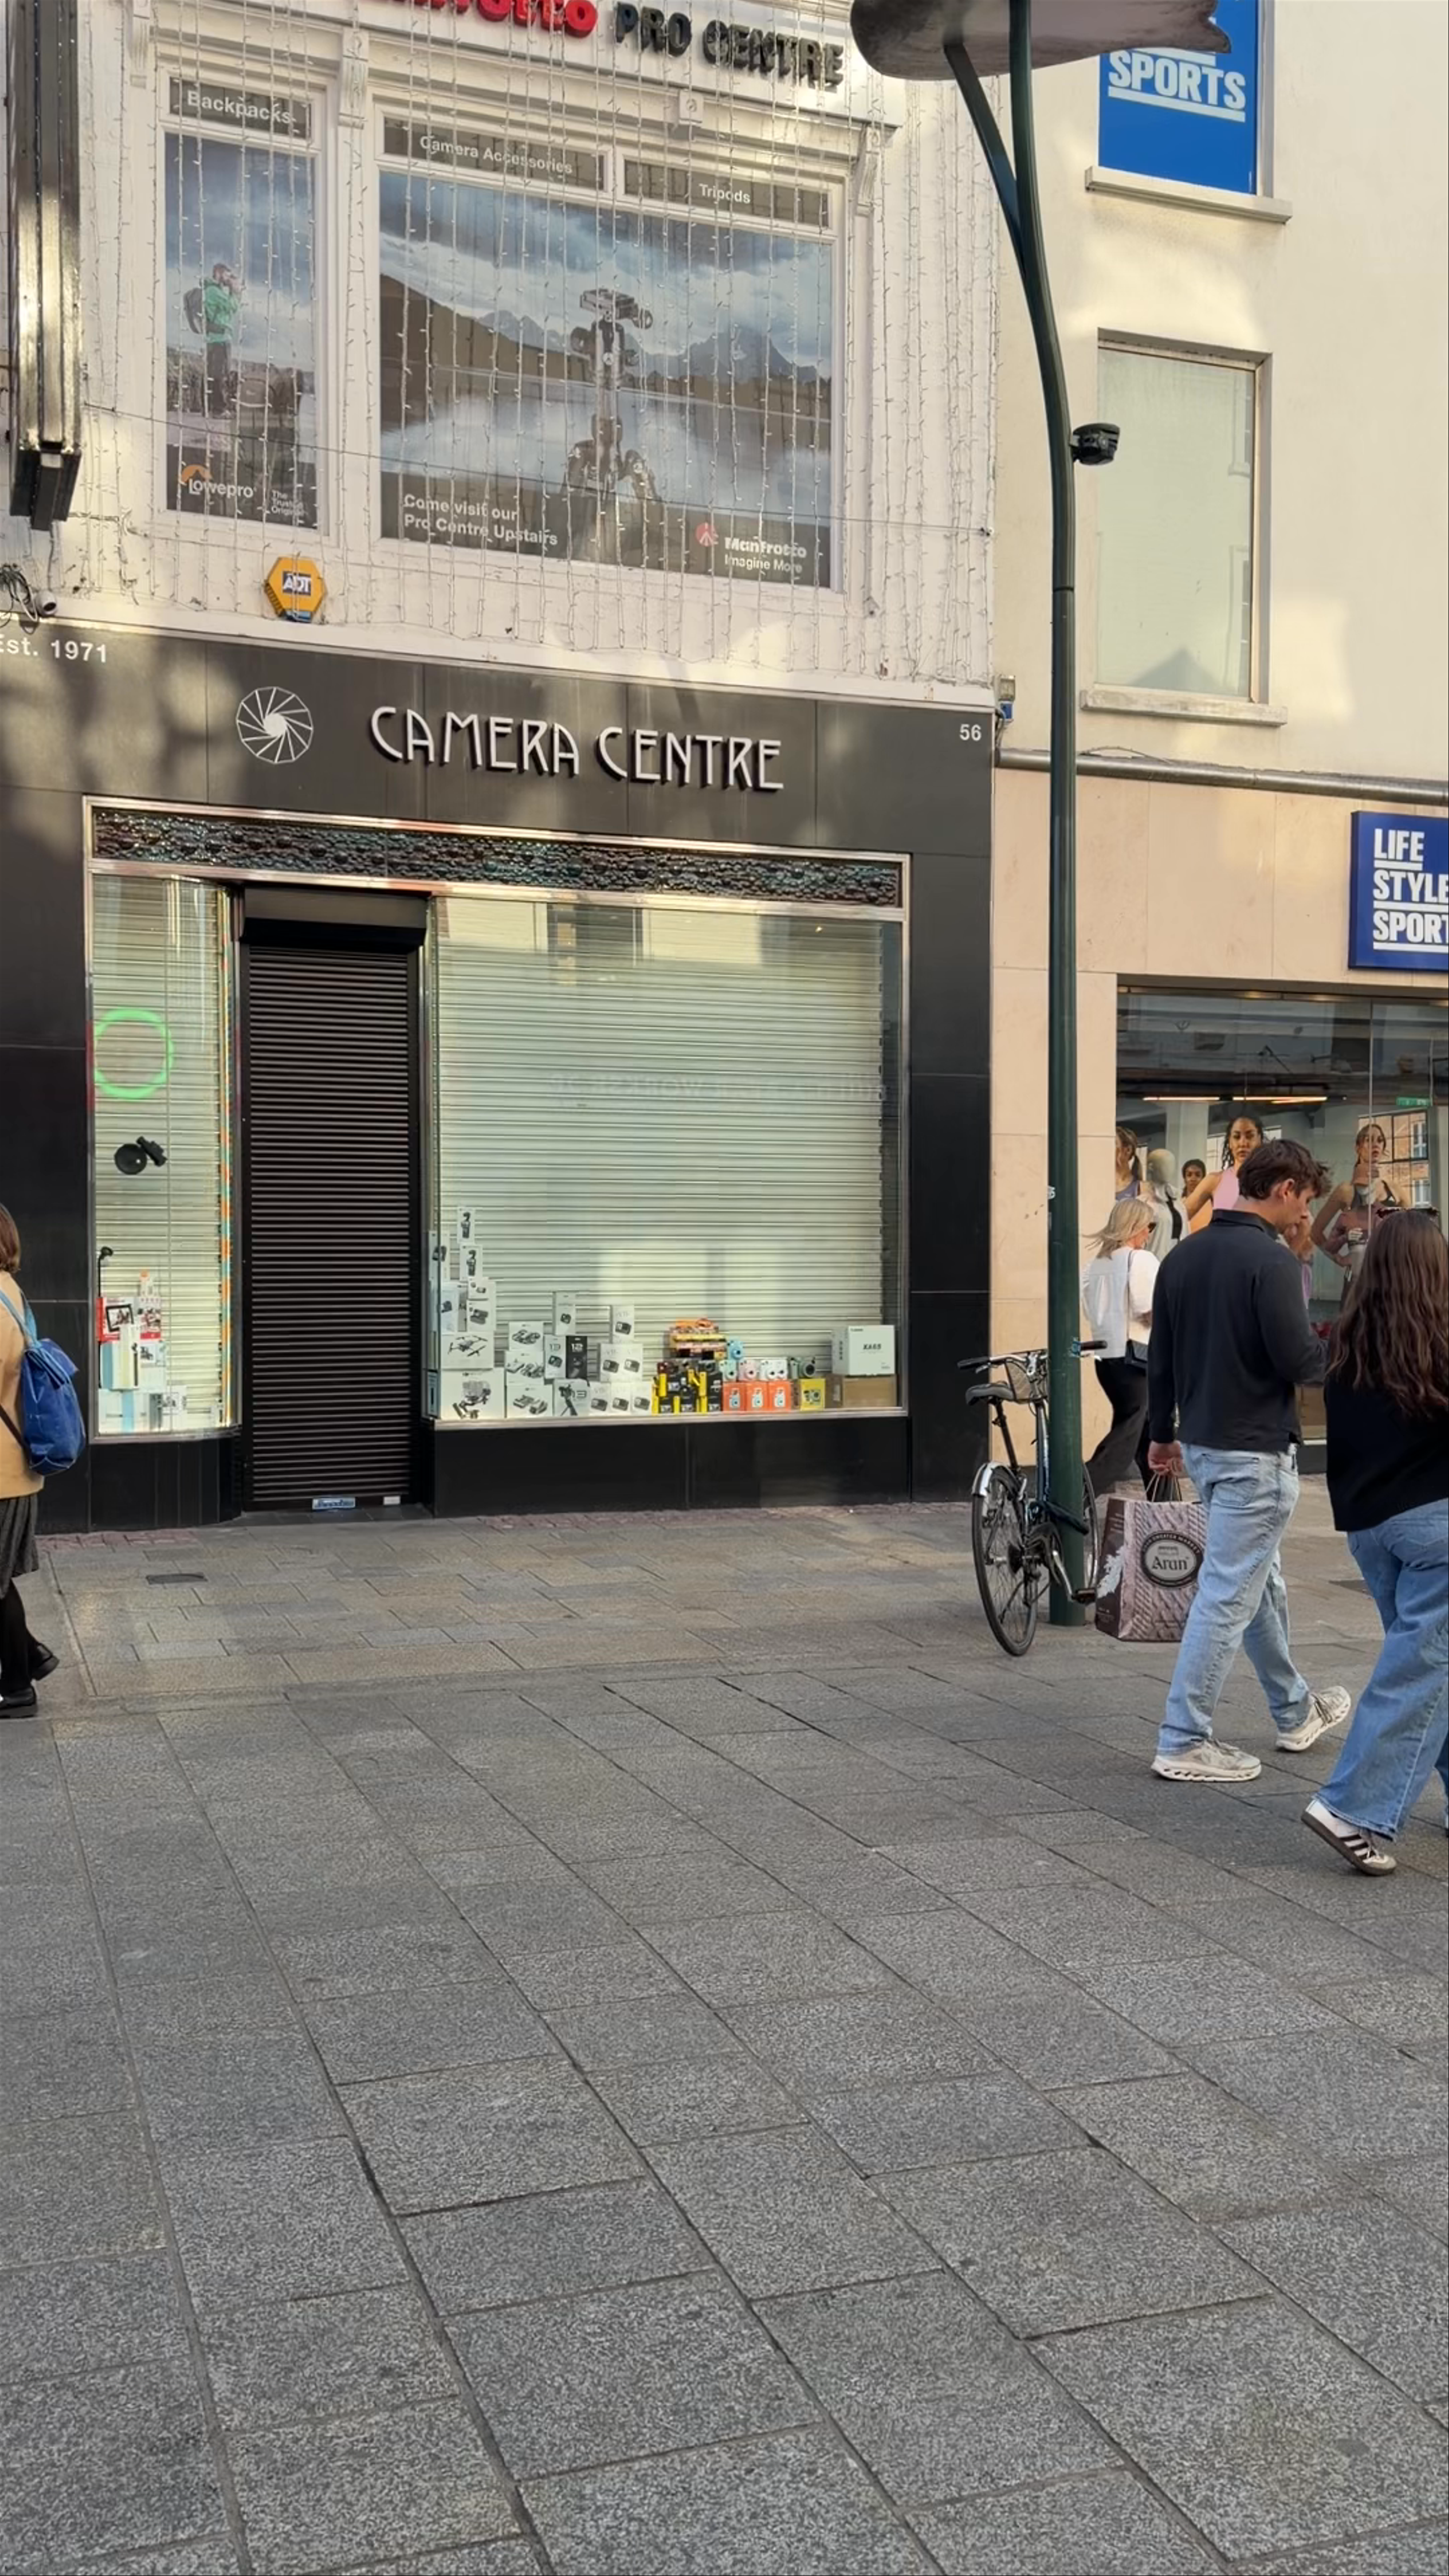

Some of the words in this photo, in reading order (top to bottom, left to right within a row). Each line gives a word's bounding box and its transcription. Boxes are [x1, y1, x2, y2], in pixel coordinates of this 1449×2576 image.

[616, 2, 692, 57] PRO
[703, 20, 844, 90] CENTRE
[1108, 50, 1245, 110] SPORTS
[187, 91, 292, 125] Backpacks
[420, 135, 478, 158] Camera
[483, 148, 572, 175] Accessories
[698, 183, 751, 204] Tripods
[189, 478, 254, 498] Lowepro
[272, 490, 287, 499] The
[404, 494, 449, 512] Come
[454, 502, 488, 517] visit
[492, 509, 517, 521] our
[405, 514, 431, 529] Pro
[436, 518, 488, 537] Centre
[494, 525, 558, 545] Upstairs
[724, 537, 807, 558] Manfrotto
[724, 554, 770, 571] Imagine
[774, 561, 803, 573] More
[283, 574, 309, 592] ADT
[51, 640, 107, 663] 1971
[960, 724, 981, 741] 56
[371, 706, 580, 775] CAMERA
[597, 726, 784, 790] CENTRE
[1374, 828, 1424, 861] LIFE
[1373, 869, 1449, 904] STYLE
